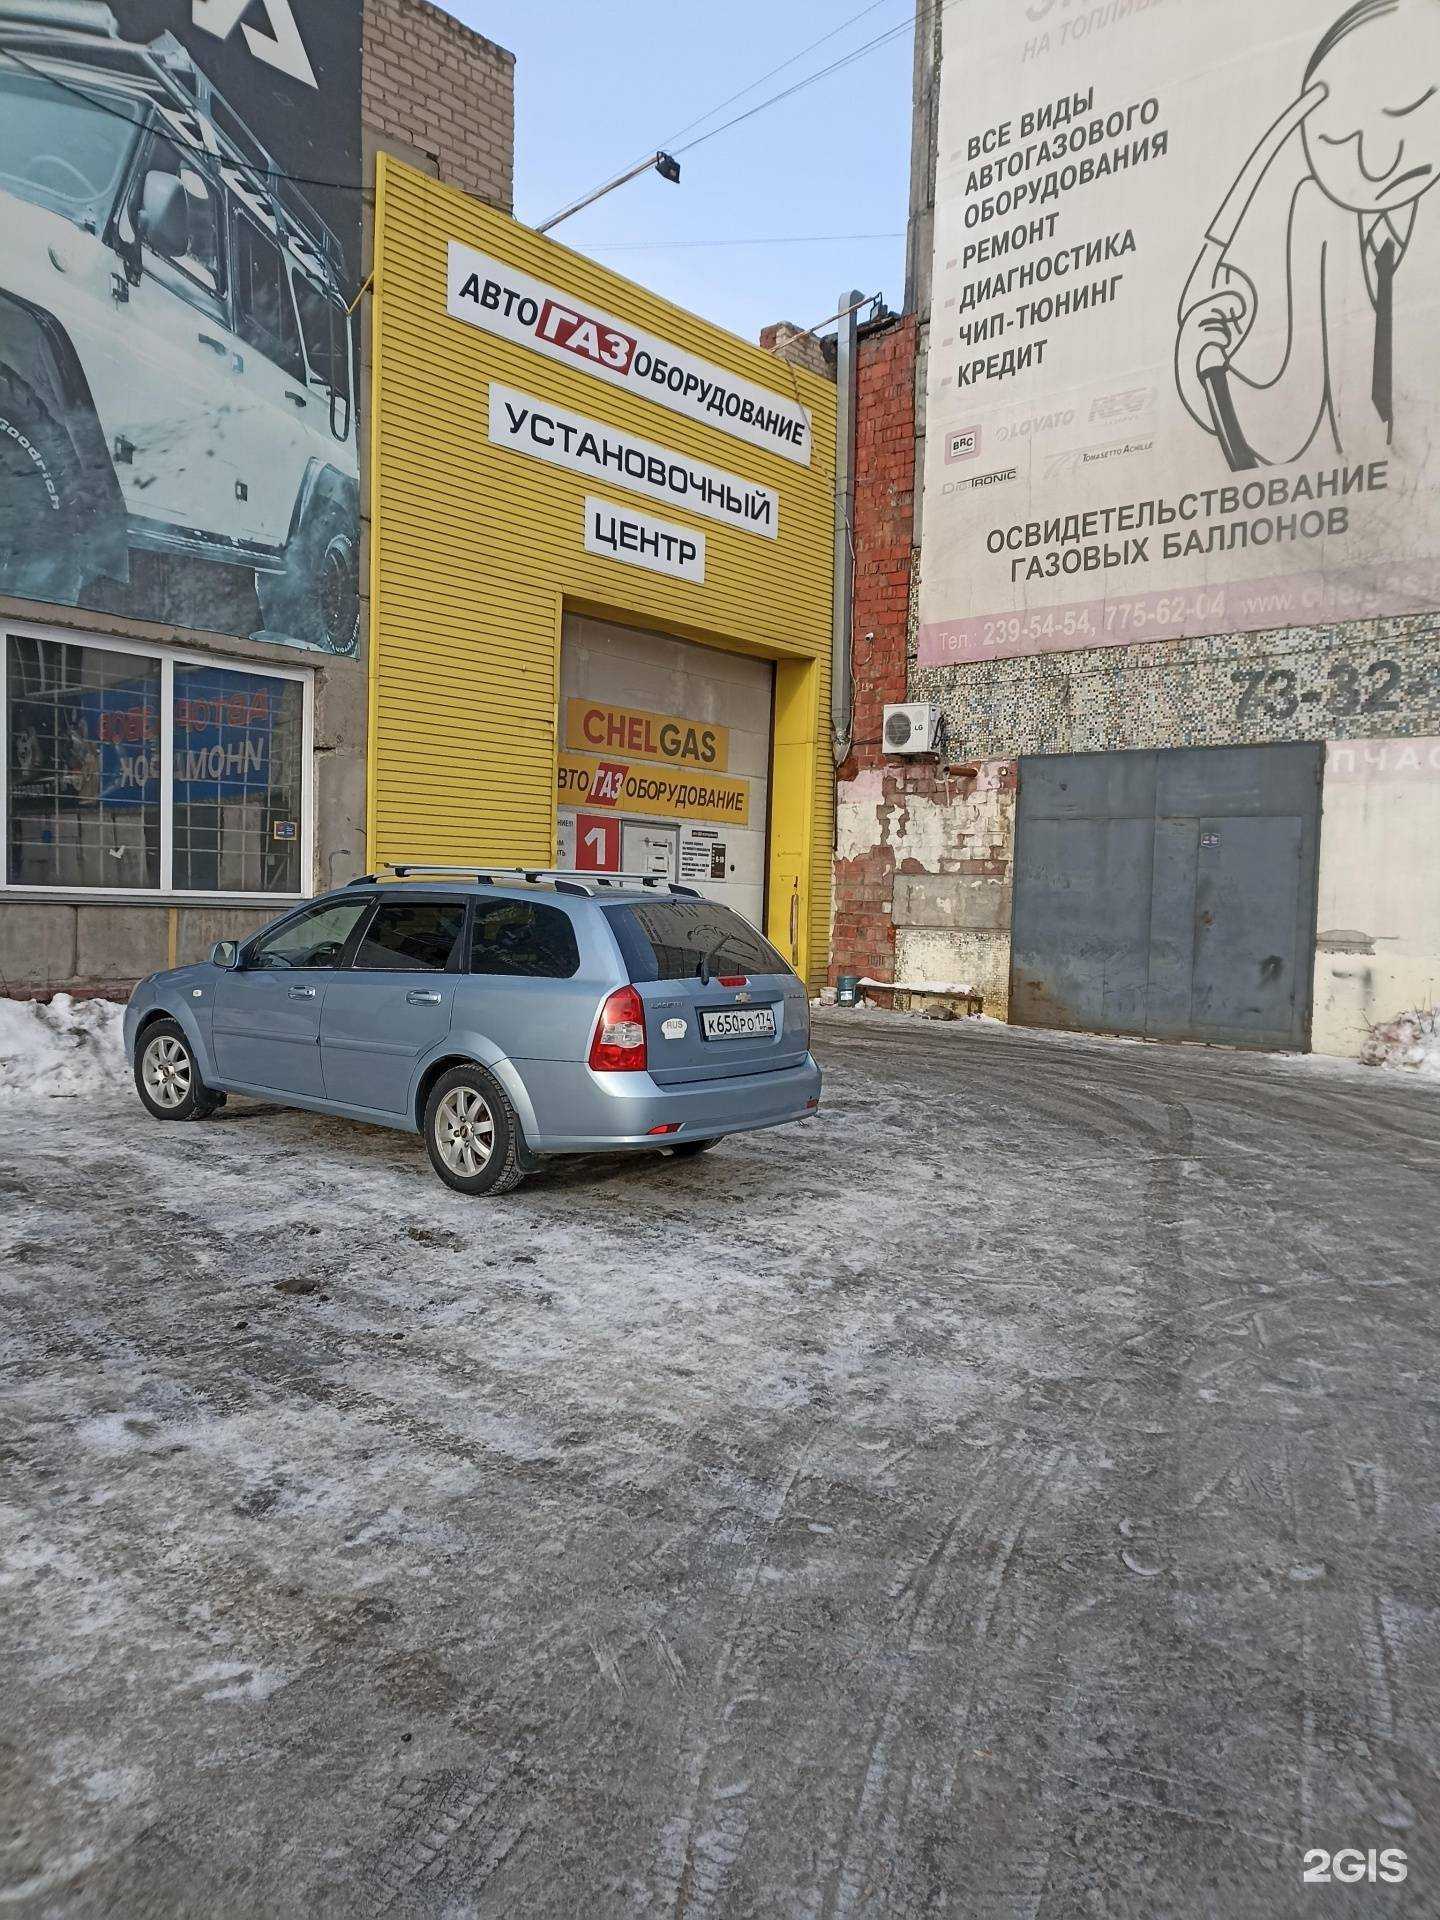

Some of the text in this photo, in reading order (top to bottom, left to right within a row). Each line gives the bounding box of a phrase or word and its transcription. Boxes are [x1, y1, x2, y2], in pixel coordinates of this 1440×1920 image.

[1021, 32, 1050, 62] НА
[1060, 0, 1163, 46] ТОПЛИВ
[964, 98, 1158, 196] АВТОГАЗОВОГО
[967, 86, 1094, 161] ВСЕ ВИДЫ
[963, 131, 1169, 229] ОБОРУДОВАНИЯ
[958, 229, 1136, 314] ДИАГНОСТИКА
[962, 212, 1060, 269] РЕМОНТ
[958, 275, 1123, 347] ЧИП-ТЮНИНГ
[957, 340, 1048, 388] КРЕДИТ
[504, 402, 771, 525] УСТАНОВОЧНЫЙ
[952, 437, 974, 451] BRC
[595, 512, 697, 565] ЦЕНТР
[986, 461, 1389, 554] ОСВИДЕТЕЛЬСТВОВАНИЕ
[1010, 506, 1349, 583] ГАЗОВЫХ БАЛЛОНОВ
[584, 827, 606, 865] 1
[666, 1020, 683, 1029] RUS
